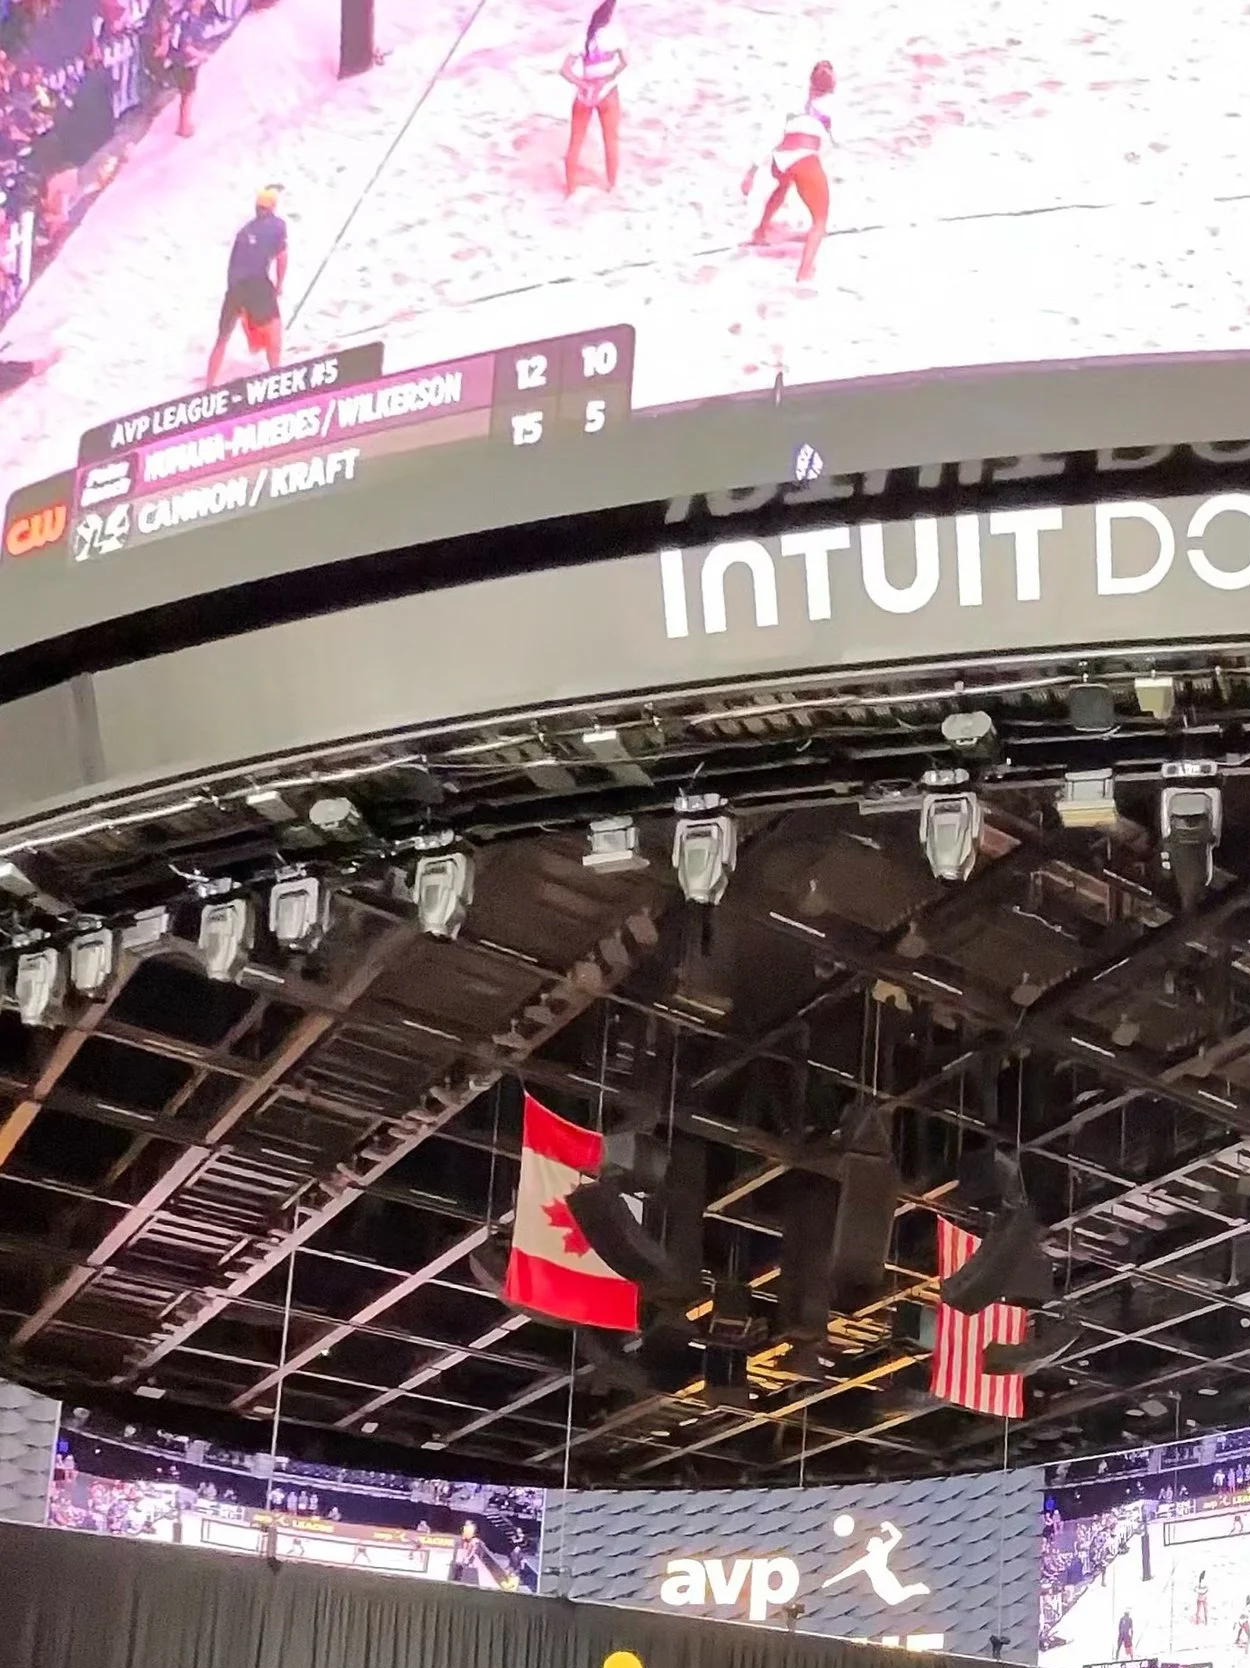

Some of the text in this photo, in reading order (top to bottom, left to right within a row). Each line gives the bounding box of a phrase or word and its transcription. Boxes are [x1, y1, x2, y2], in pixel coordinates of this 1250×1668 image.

[516, 342, 617, 390] 12 10
[111, 416, 150, 449] AVP
[152, 390, 230, 435] LEAGUE
[246, 367, 307, 405] WEEK
[511, 400, 606, 445] 15 5
[137, 476, 248, 534] CANNON
[269, 447, 361, 498] KRAFT
[660, 1556, 800, 1621] avp
